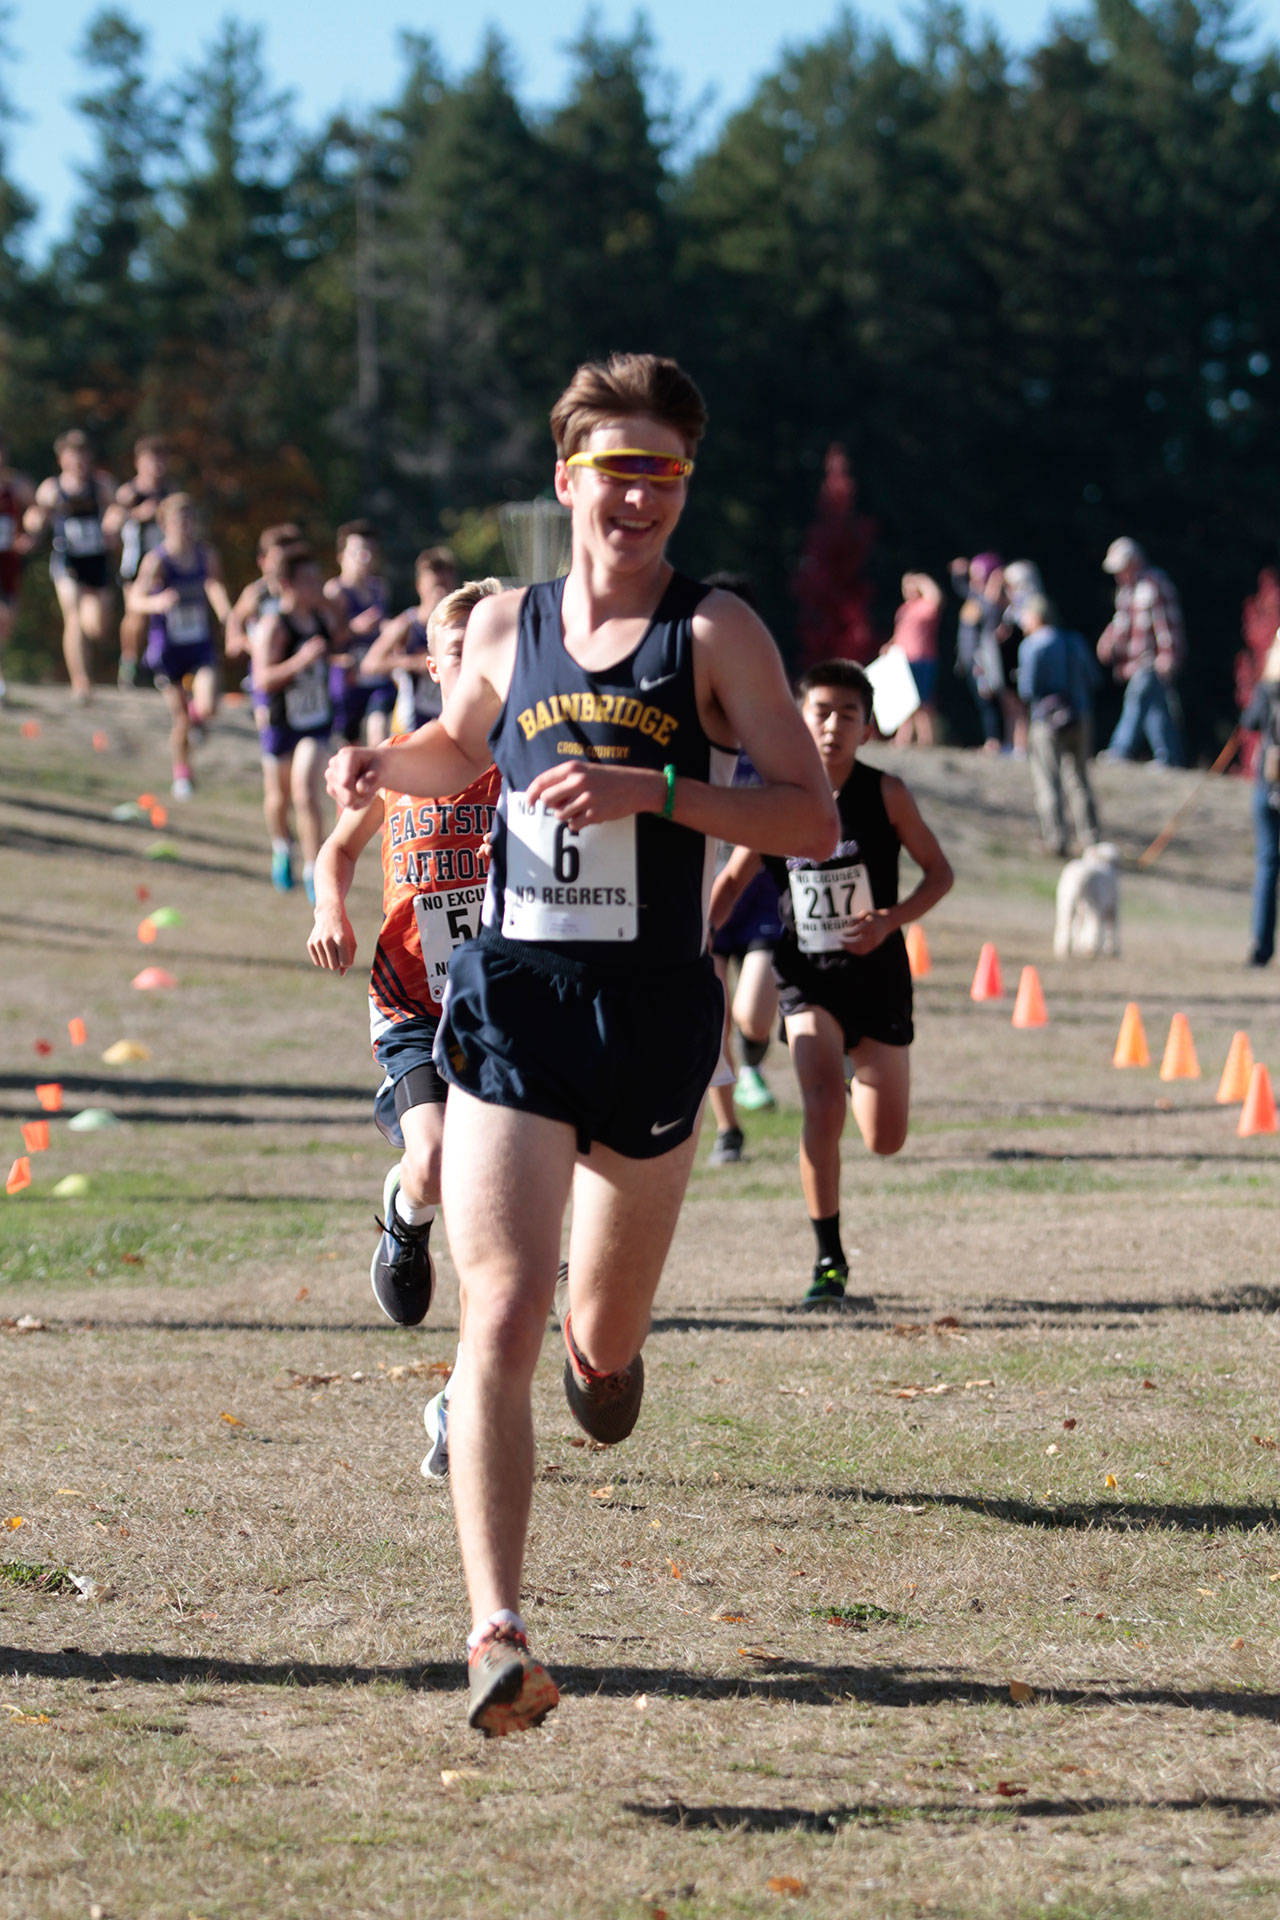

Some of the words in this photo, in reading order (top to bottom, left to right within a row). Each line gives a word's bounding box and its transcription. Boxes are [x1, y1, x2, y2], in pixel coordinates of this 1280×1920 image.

[517, 692, 679, 746] BAINBRIDGE
[557, 741, 584, 756] CROSS
[554, 821, 580, 884] 6
[422, 894, 443, 911] NO
[516, 887, 535, 903] NO
[804, 882, 856, 920] 217
[446, 905, 482, 950] 5
